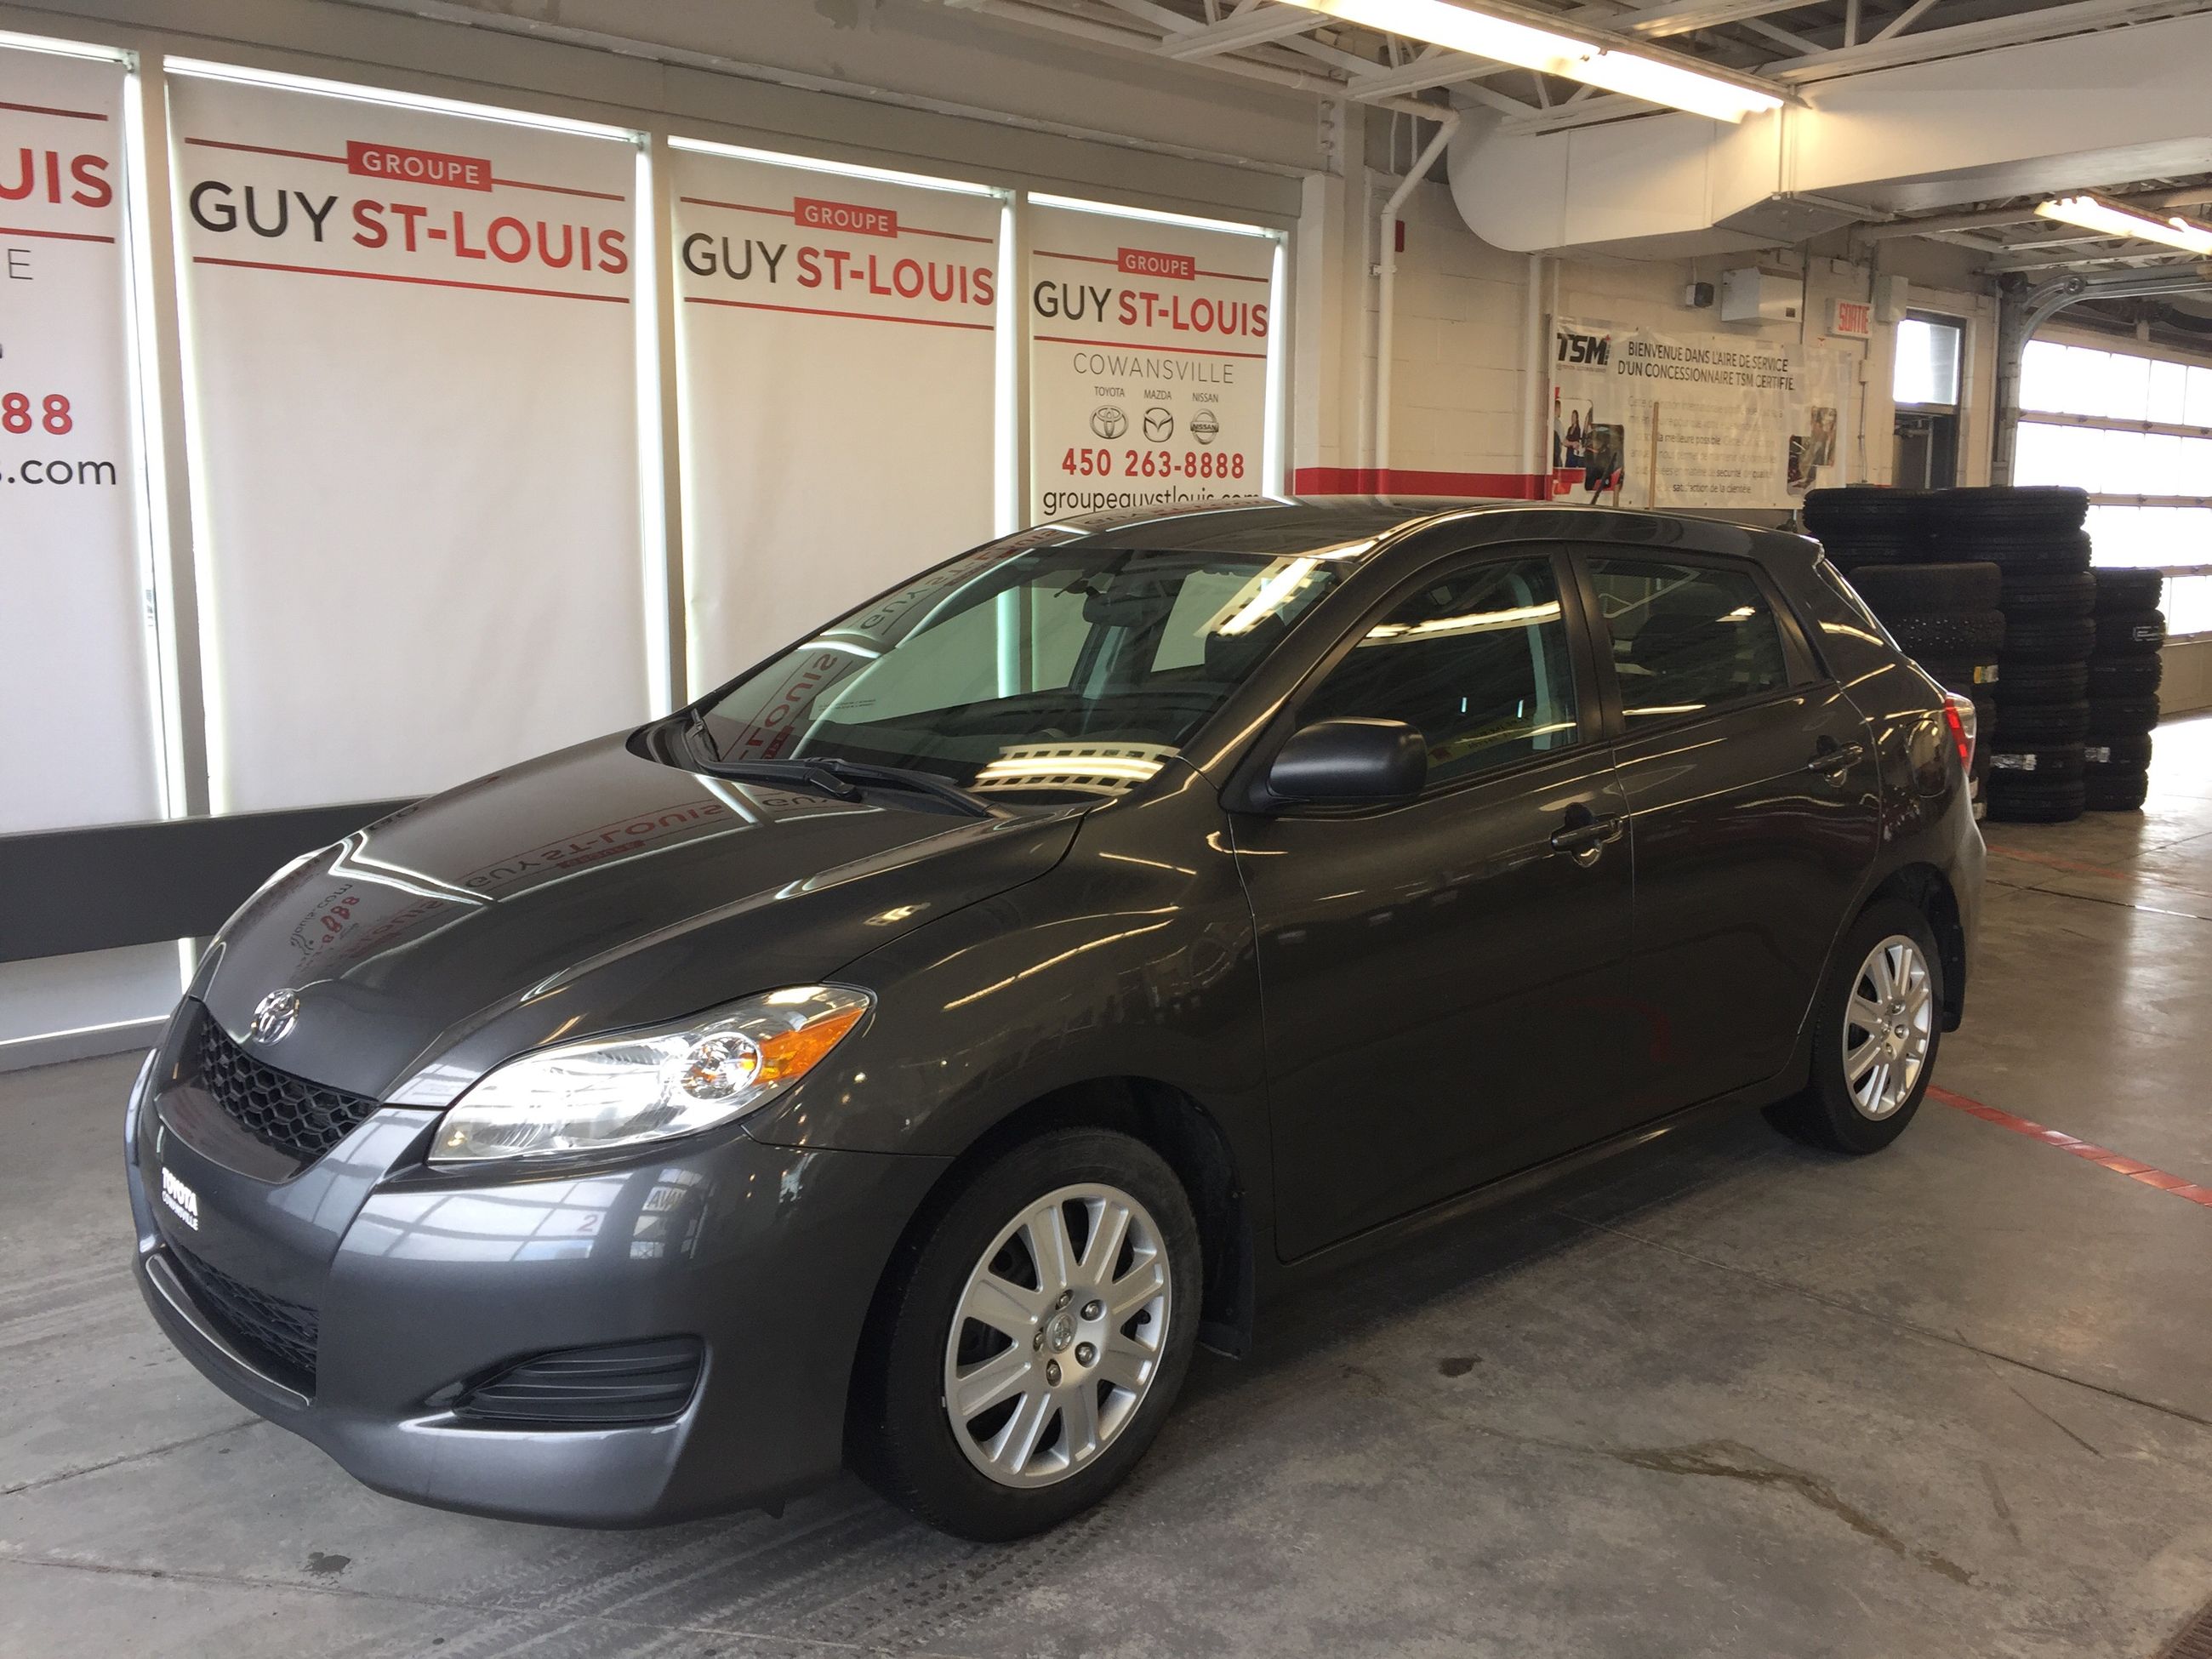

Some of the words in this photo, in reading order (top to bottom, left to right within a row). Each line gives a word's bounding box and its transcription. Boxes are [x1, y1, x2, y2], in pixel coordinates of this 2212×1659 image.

[362, 150, 482, 185] GROUPE
[189, 180, 339, 242] GUY
[351, 198, 630, 275] ST-LOUIS
[804, 205, 889, 232] GROUPE
[682, 232, 788, 284] GUY
[795, 246, 995, 306] ST-LOUIS
[1125, 254, 1189, 276] GROUPE
[1033, 280, 1112, 322] GUY
[1118, 289, 1268, 338] ST-LOUIS
[1839, 302, 1870, 334] SORTIE
[1557, 333, 1608, 366] TSM
[1628, 341, 1684, 362] BIENVENUE
[1685, 347, 1711, 364] DANS
[1739, 354, 1751, 369] DE
[1752, 356, 1788, 373] SERVICE
[1073, 352, 1234, 384] COWANSVILLE
[1617, 360, 1643, 376] D'UN
[1645, 363, 1734, 385] CONCESSIONNAIRE
[1736, 372, 1753, 388] TSM
[1094, 385, 1126, 398] TOYOTA
[1143, 389, 1172, 401] MAZDA
[1192, 392, 1219, 403] NISSAN
[0, 459, 117, 485] .com
[1061, 448, 1111, 476] 450
[1125, 449, 1245, 479] 263-8888
[162, 1166, 198, 1217] TOYOTA
